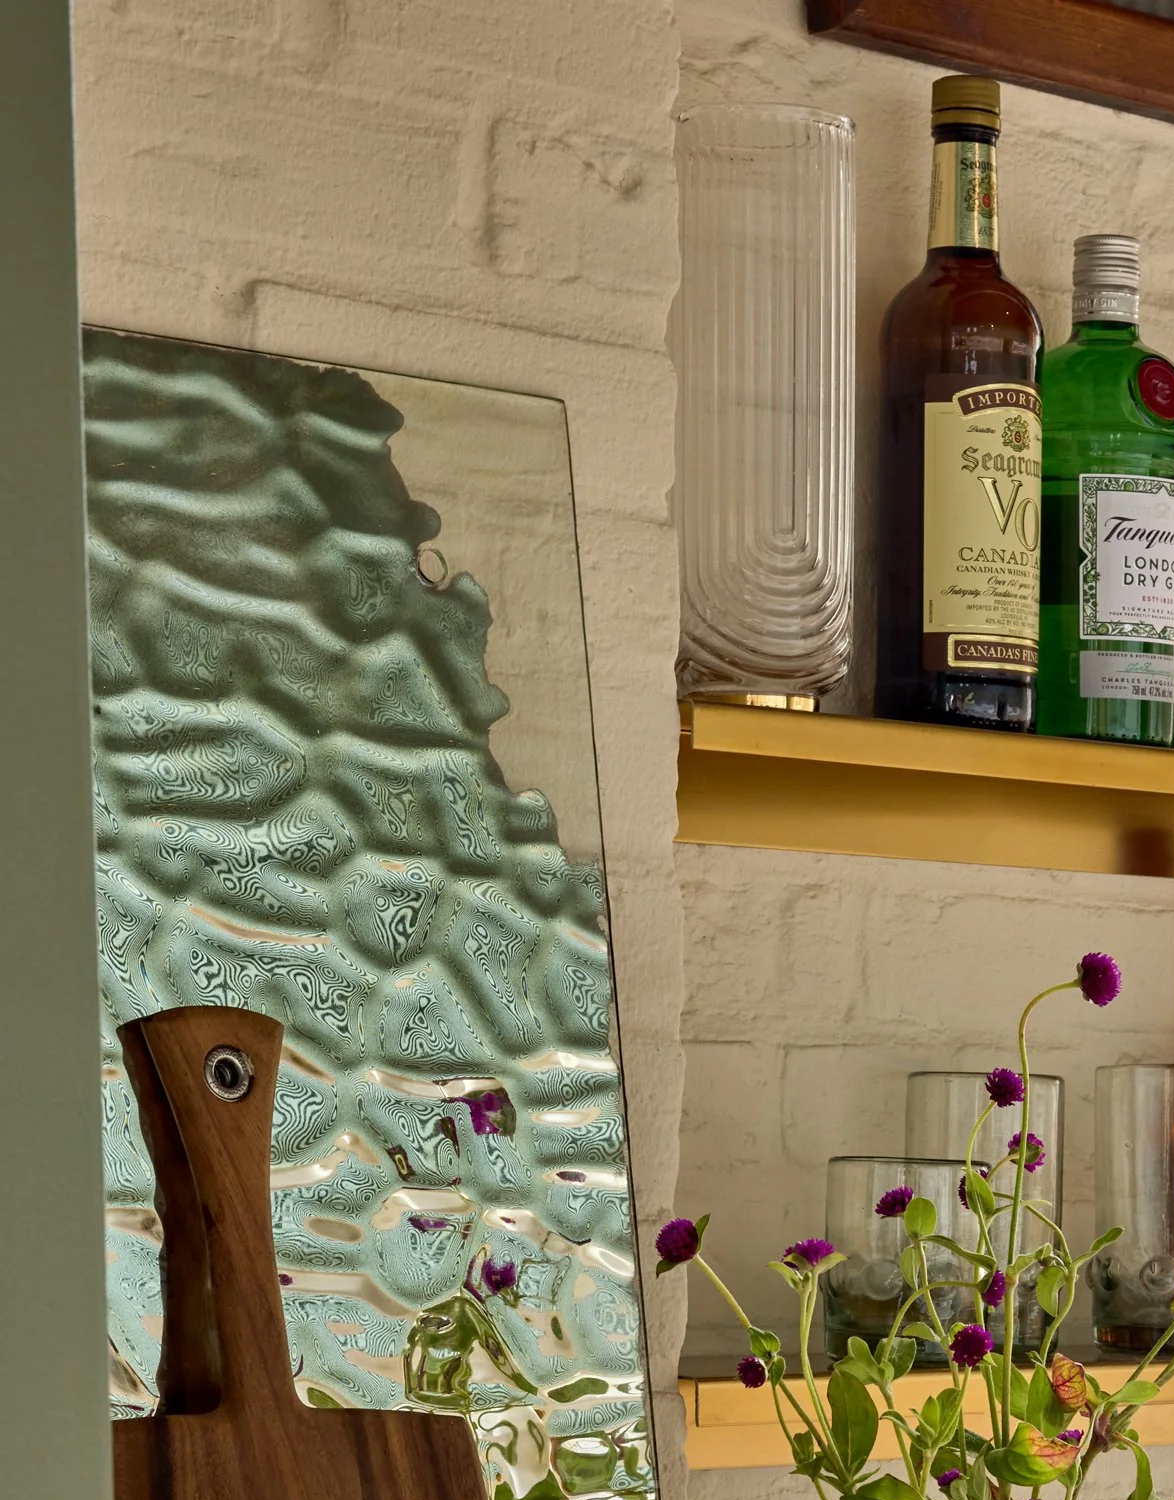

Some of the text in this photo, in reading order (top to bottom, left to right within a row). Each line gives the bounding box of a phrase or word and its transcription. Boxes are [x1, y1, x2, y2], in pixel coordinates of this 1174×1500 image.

[1100, 298, 1118, 308] GIN
[956, 564, 1006, 576] CANADIAN
[1123, 572, 1159, 588] DRY
[1121, 606, 1164, 615] SIGNATURE
[957, 644, 1021, 660] CANADA'S
[1101, 676, 1141, 685] CHARLES
